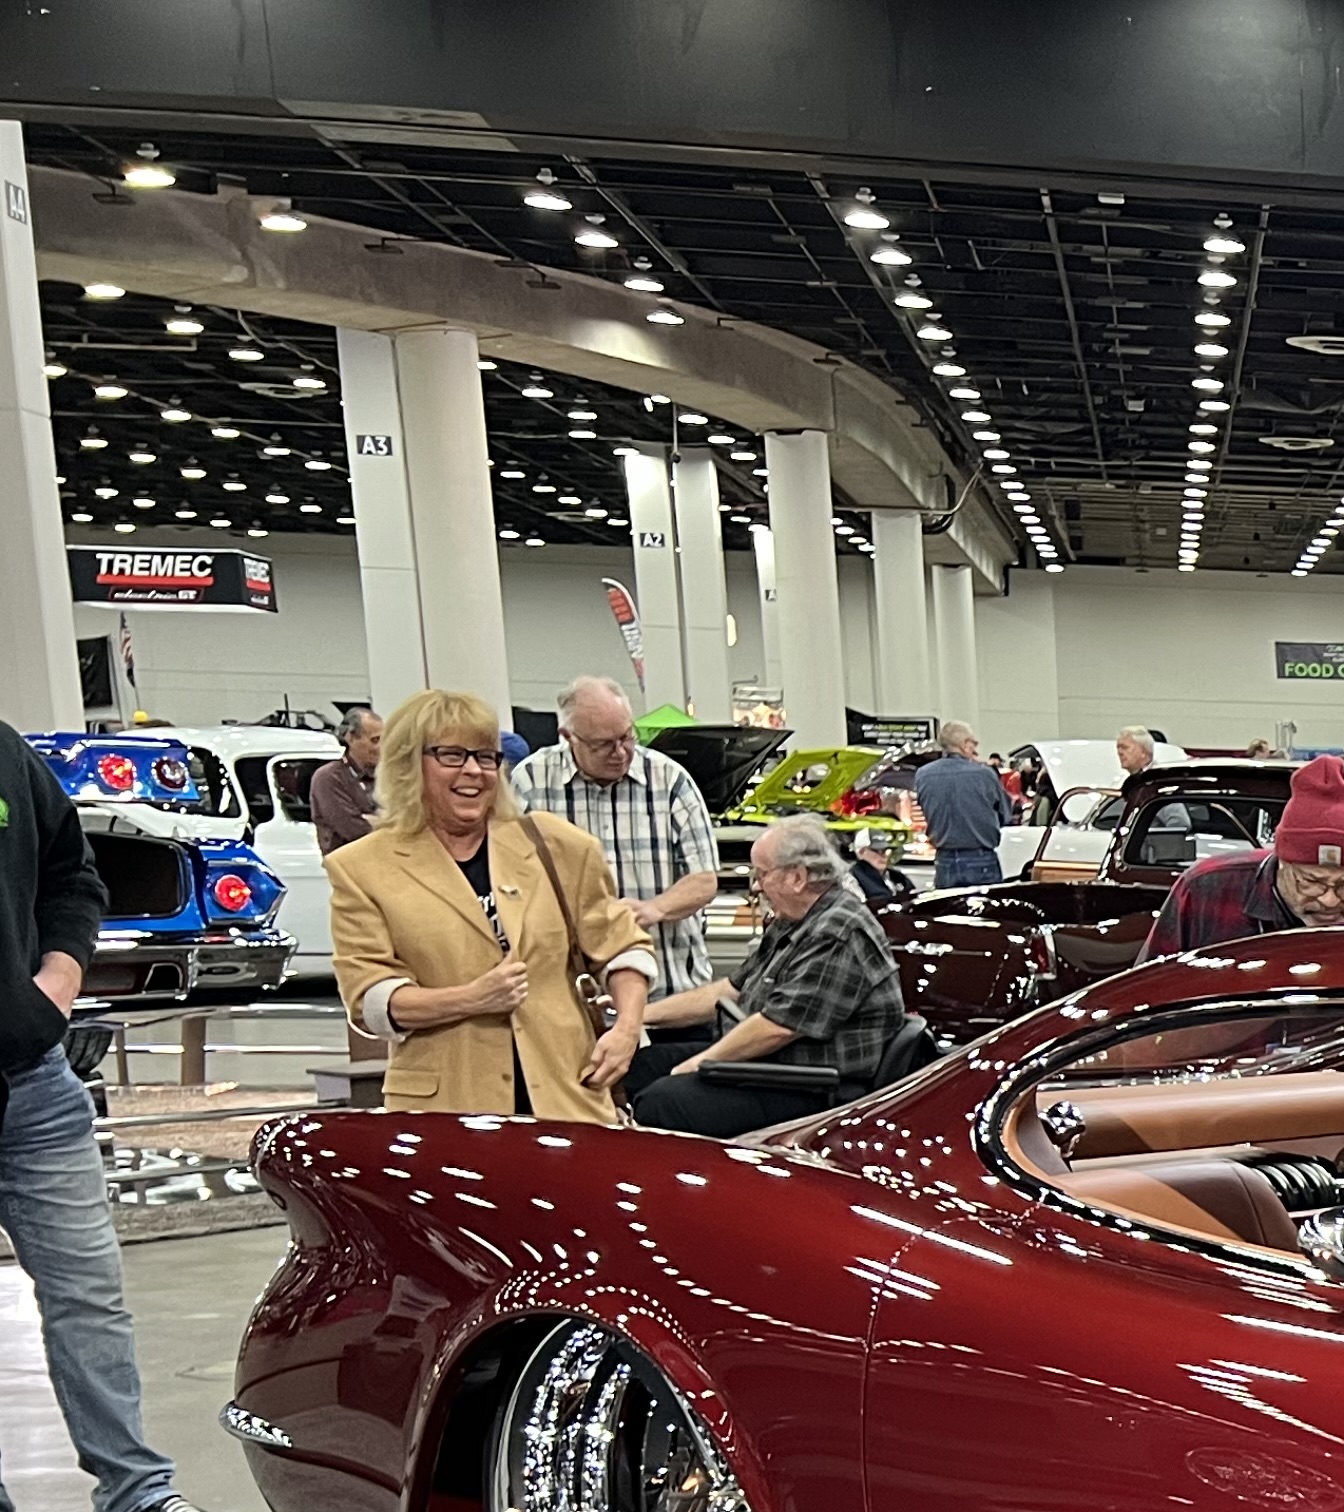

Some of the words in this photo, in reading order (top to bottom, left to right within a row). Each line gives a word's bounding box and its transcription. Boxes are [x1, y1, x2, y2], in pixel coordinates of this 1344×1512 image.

[9, 184, 26, 223] A4
[362, 435, 389, 455] A3
[643, 533, 663, 547] A2
[96, 552, 213, 577] TREMEC
[1284, 662, 1334, 678] FOOD
